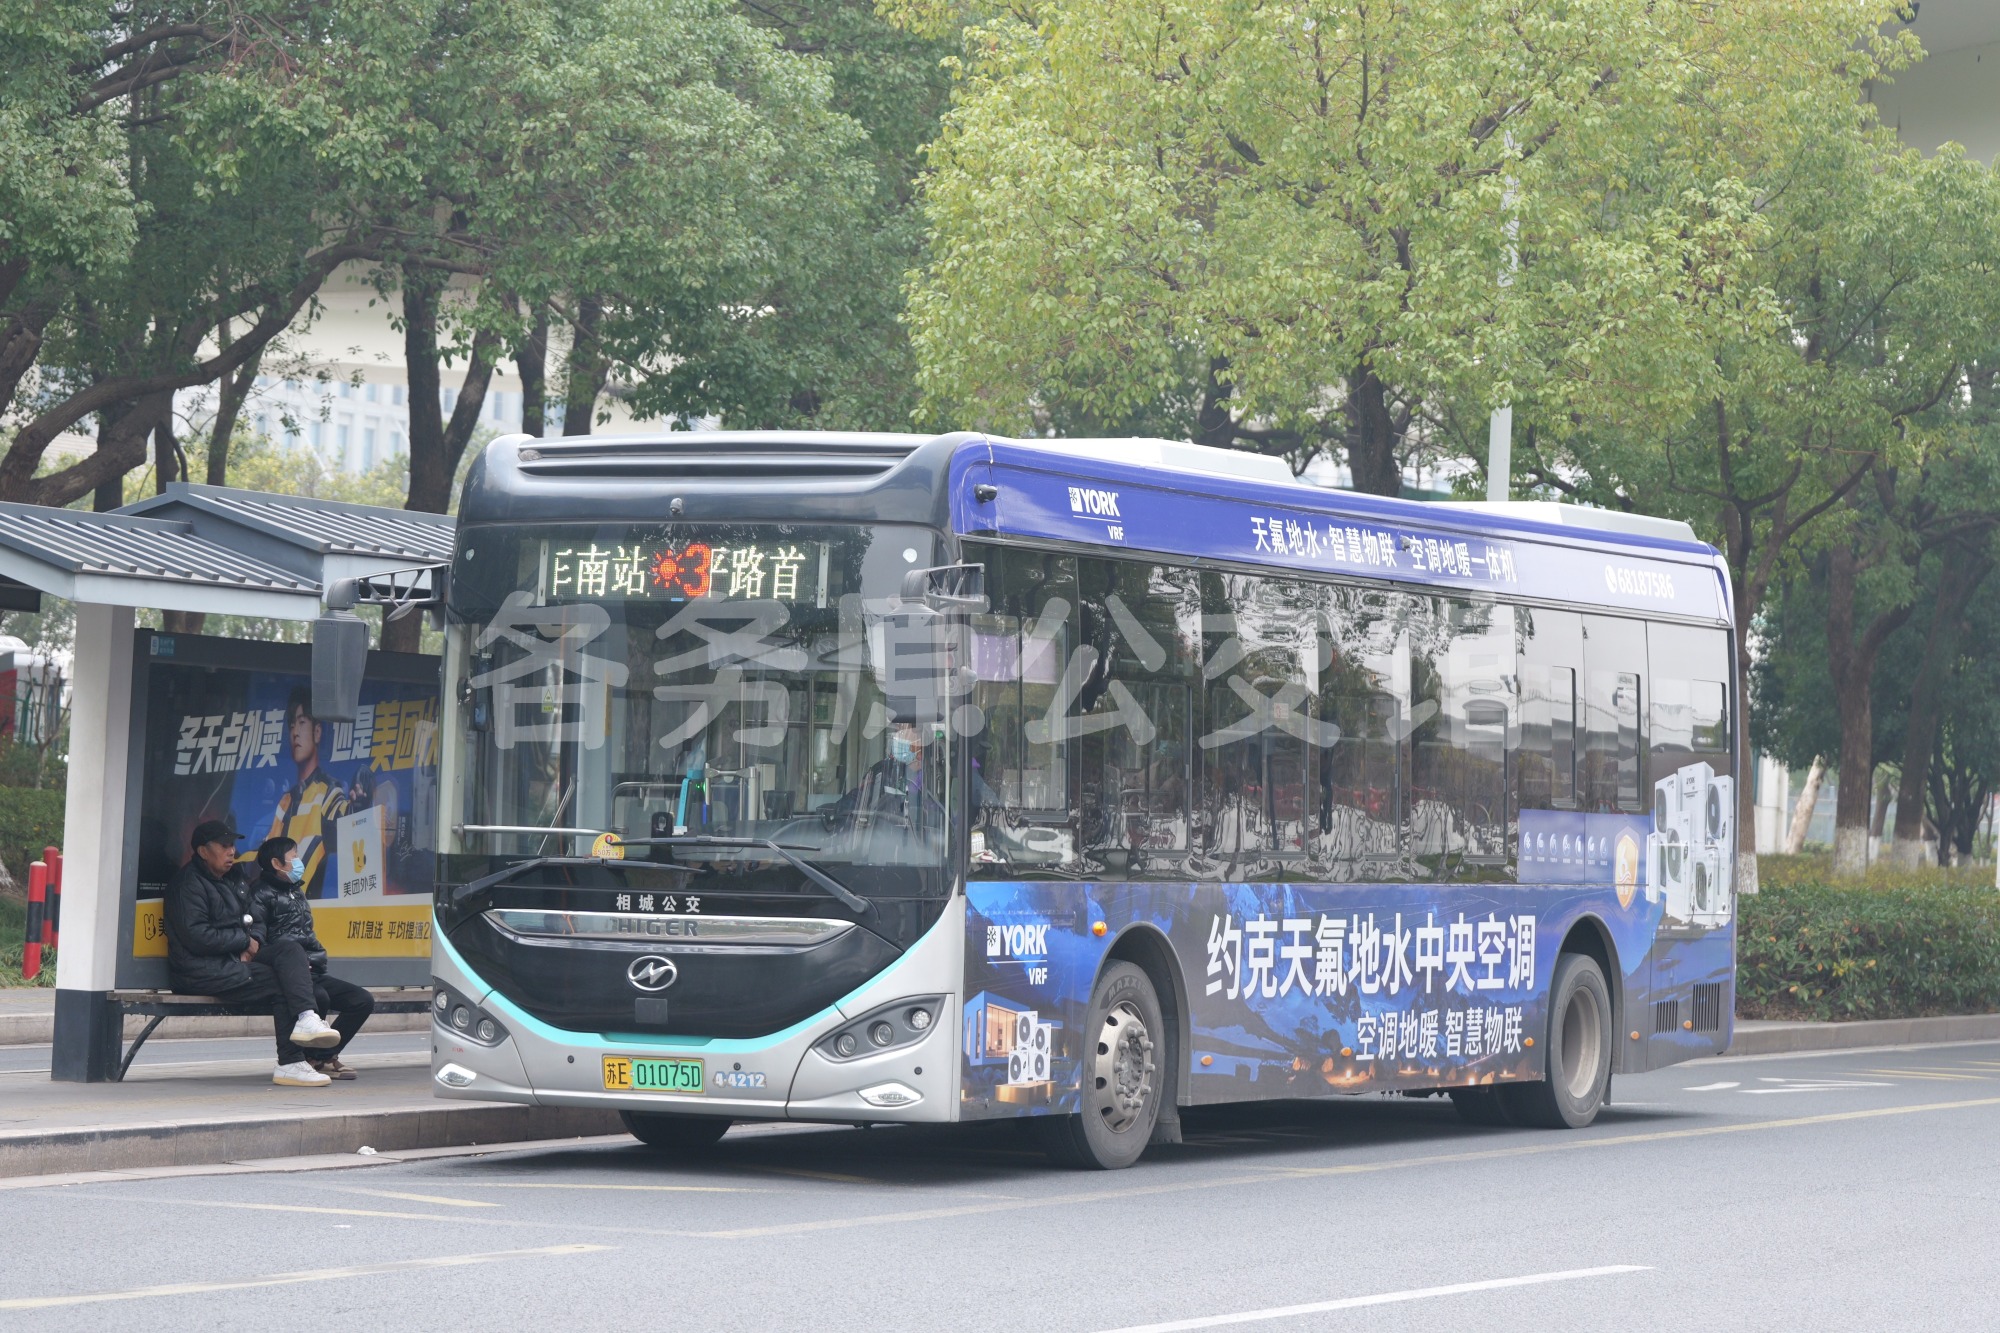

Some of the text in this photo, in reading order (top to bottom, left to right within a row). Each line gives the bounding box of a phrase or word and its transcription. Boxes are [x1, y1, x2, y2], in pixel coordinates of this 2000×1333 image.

[1080, 488, 1120, 517] YORK
[1107, 525, 1124, 541] VRF
[1408, 535, 1518, 583] 空调地暖一体机
[1617, 567, 1675, 599] 68187586
[174, 708, 286, 775] 冬天点外卖
[343, 874, 378, 898] 美团外卖
[616, 893, 701, 913] 相城公交
[347, 920, 432, 940] 1对1急送 平均提速2
[617, 918, 699, 937] HIGER
[1001, 924, 1048, 956] YORK
[1206, 913, 1536, 1000] 约克天氟地水中央空调
[1028, 967, 1048, 985] VRF
[1356, 1006, 1523, 1061] 空调地暖 智慧物联
